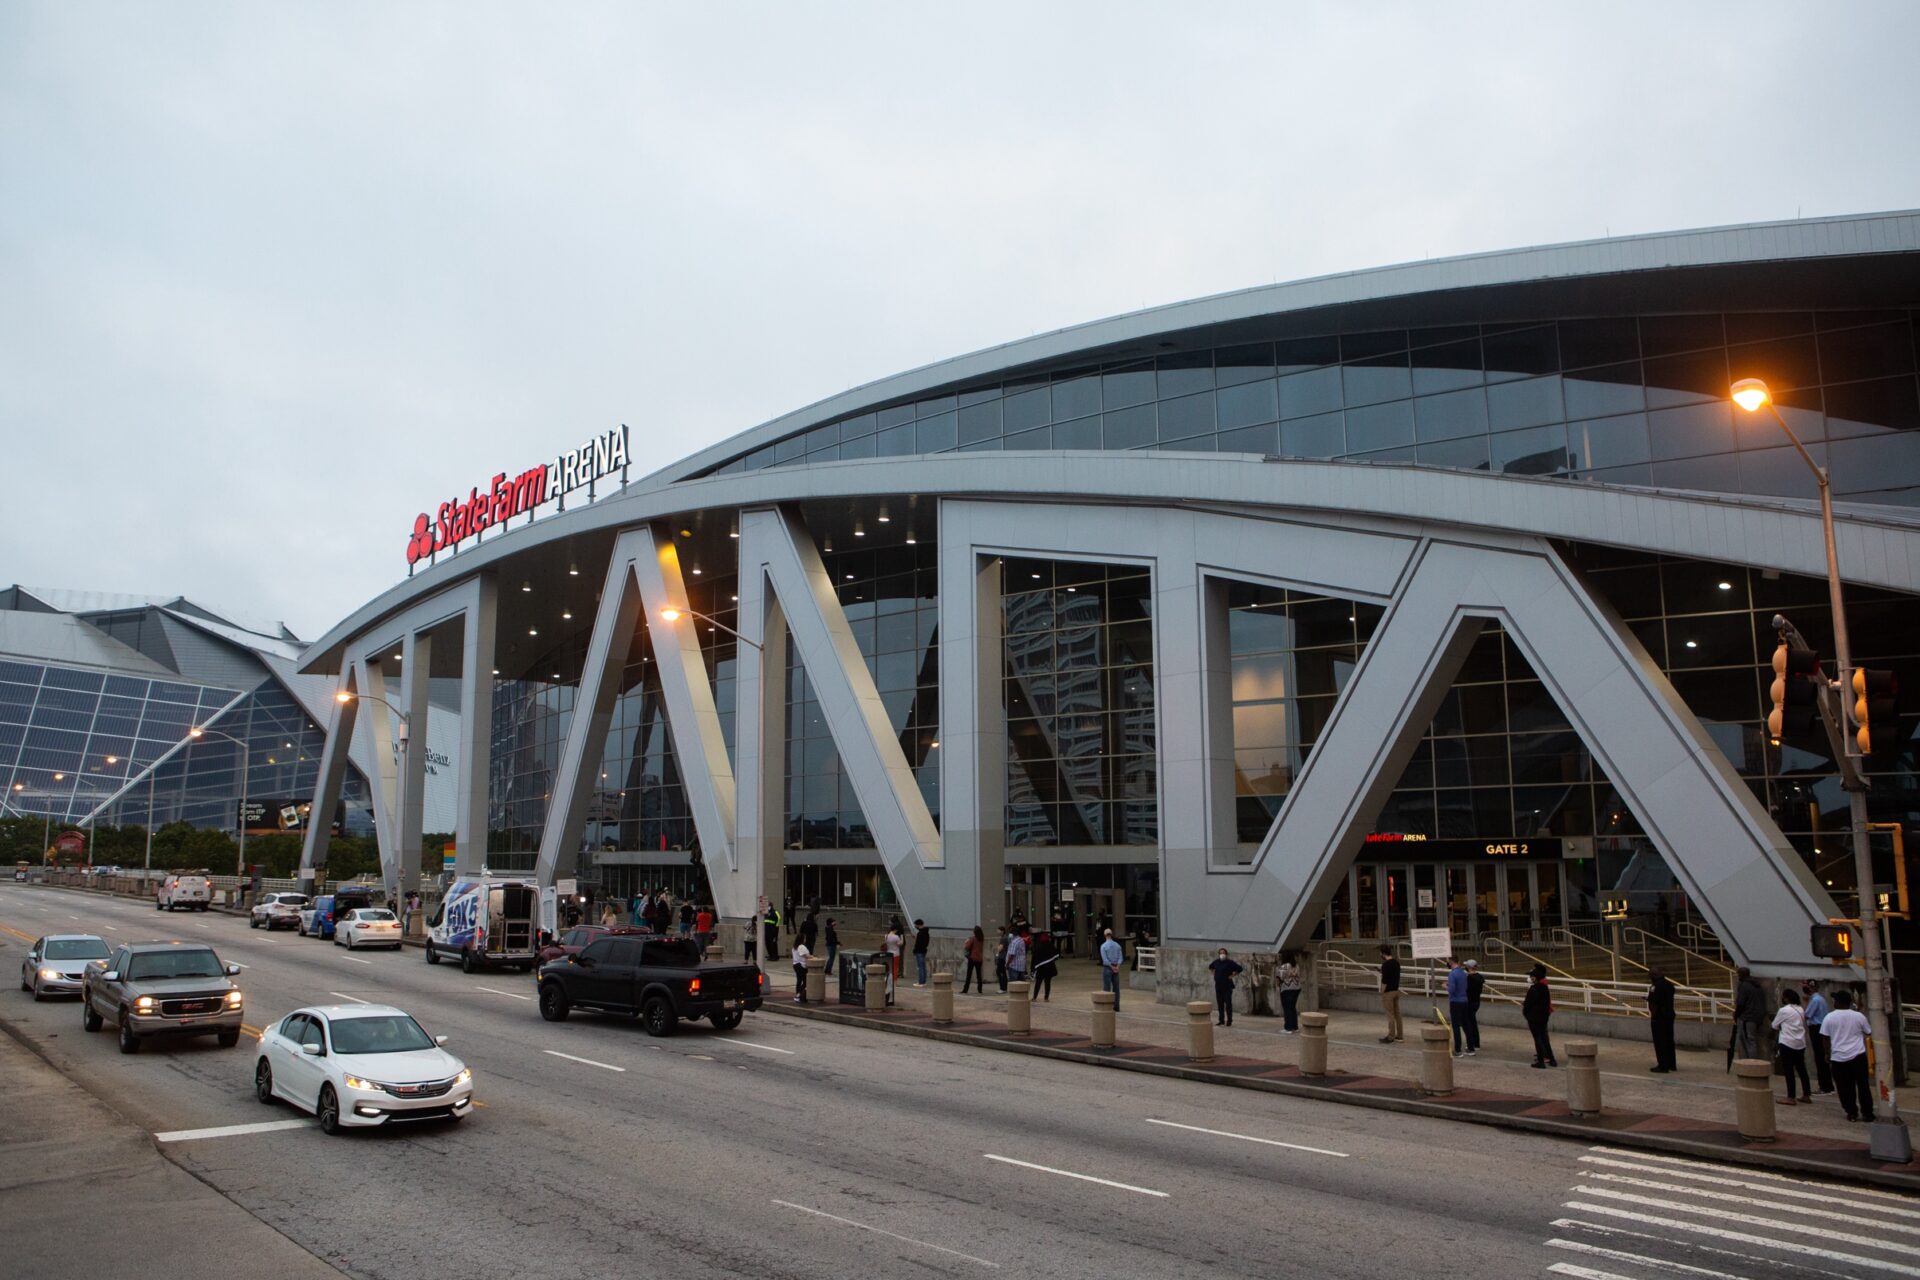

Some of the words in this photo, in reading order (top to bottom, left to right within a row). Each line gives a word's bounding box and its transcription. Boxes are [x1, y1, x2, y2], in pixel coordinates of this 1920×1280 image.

[546, 424, 630, 500] ARENA
[1403, 834, 1427, 842] ARENA
[1486, 844, 1518, 855] GATE
[1520, 844, 1529, 854] 2
[447, 899, 470, 936] FOX
[468, 895, 479, 927] 5
[1837, 933, 1849, 952] 4
